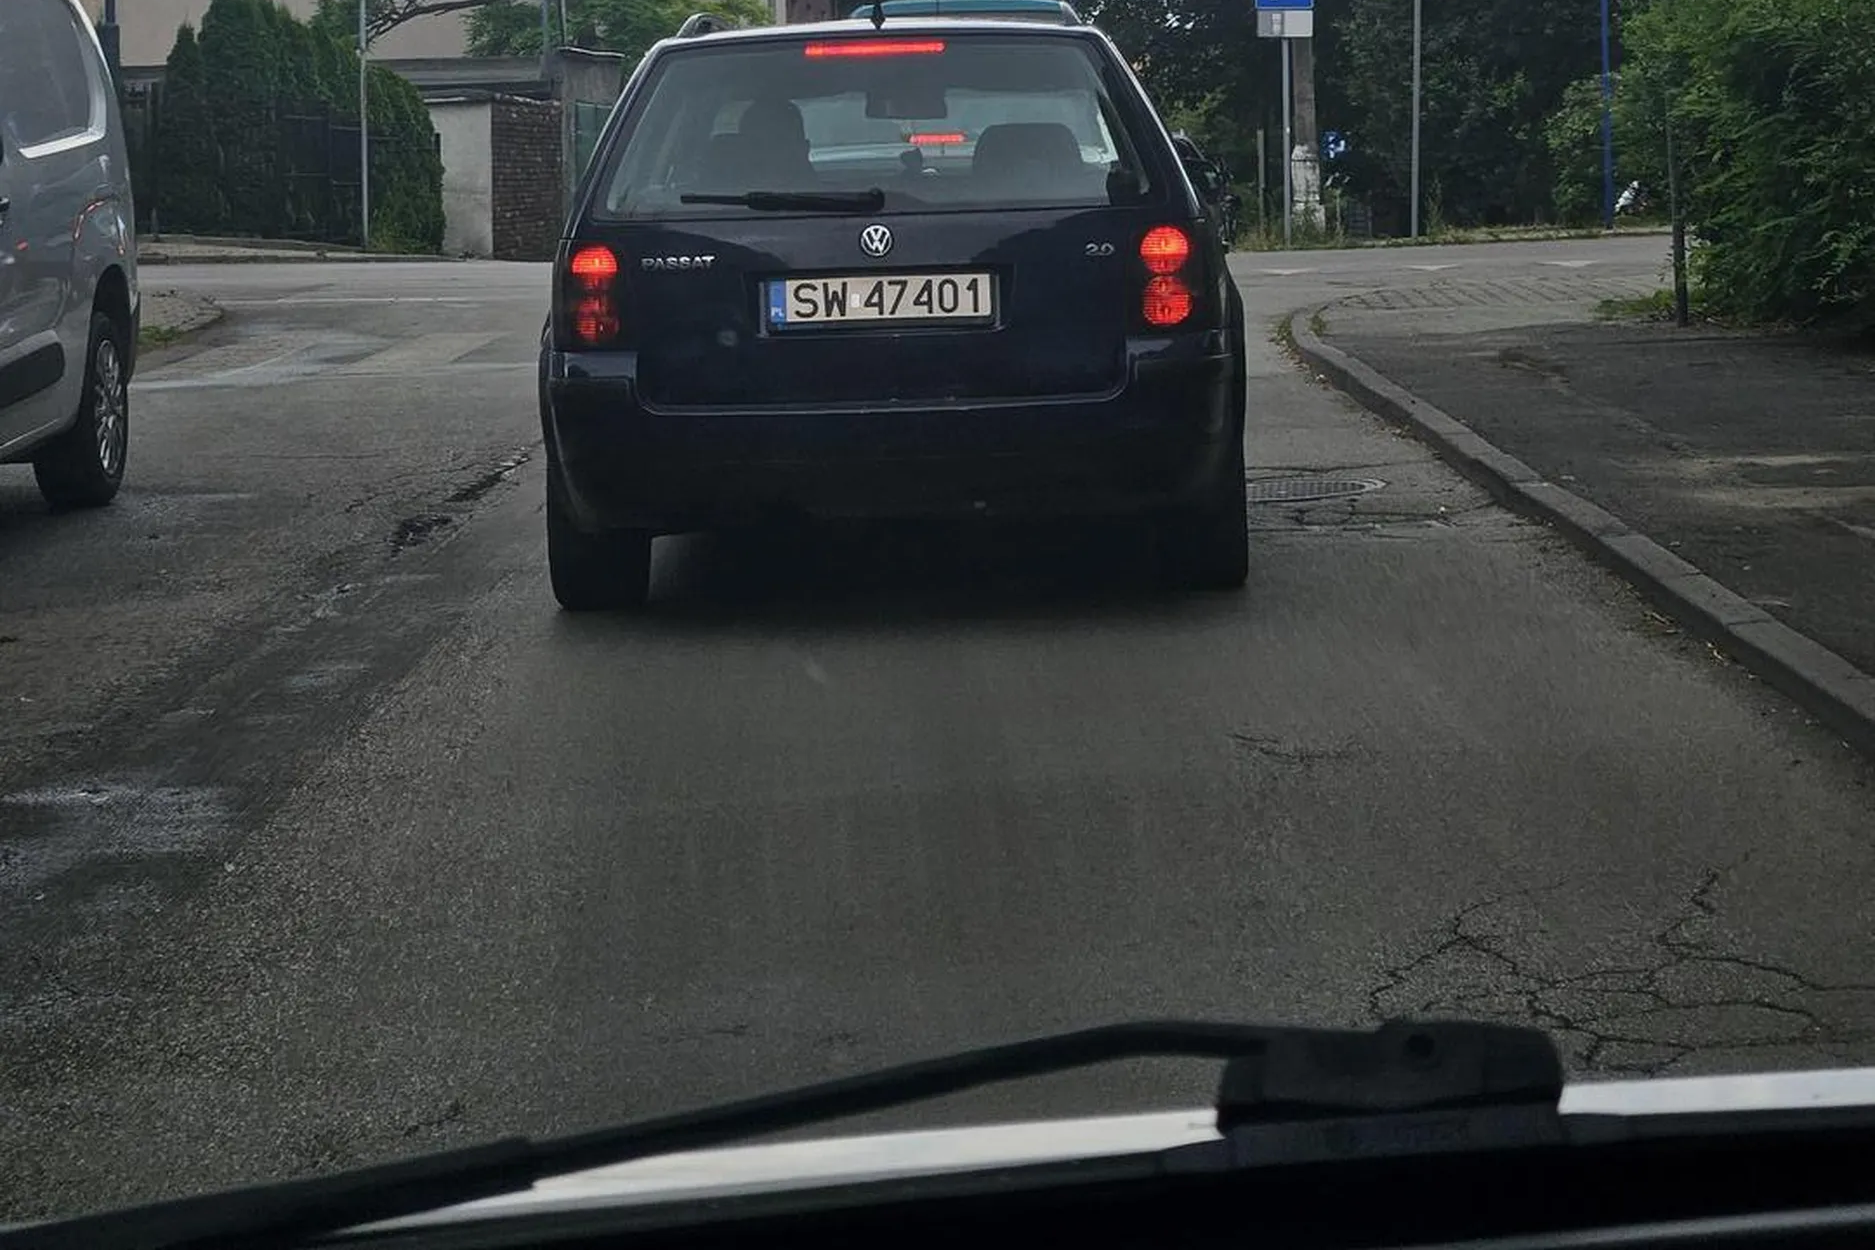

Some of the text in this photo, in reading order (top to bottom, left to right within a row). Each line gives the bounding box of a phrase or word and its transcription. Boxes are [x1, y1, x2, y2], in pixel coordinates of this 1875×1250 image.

[641, 255, 716, 271] PASSAT
[792, 277, 979, 319] SW 47401
